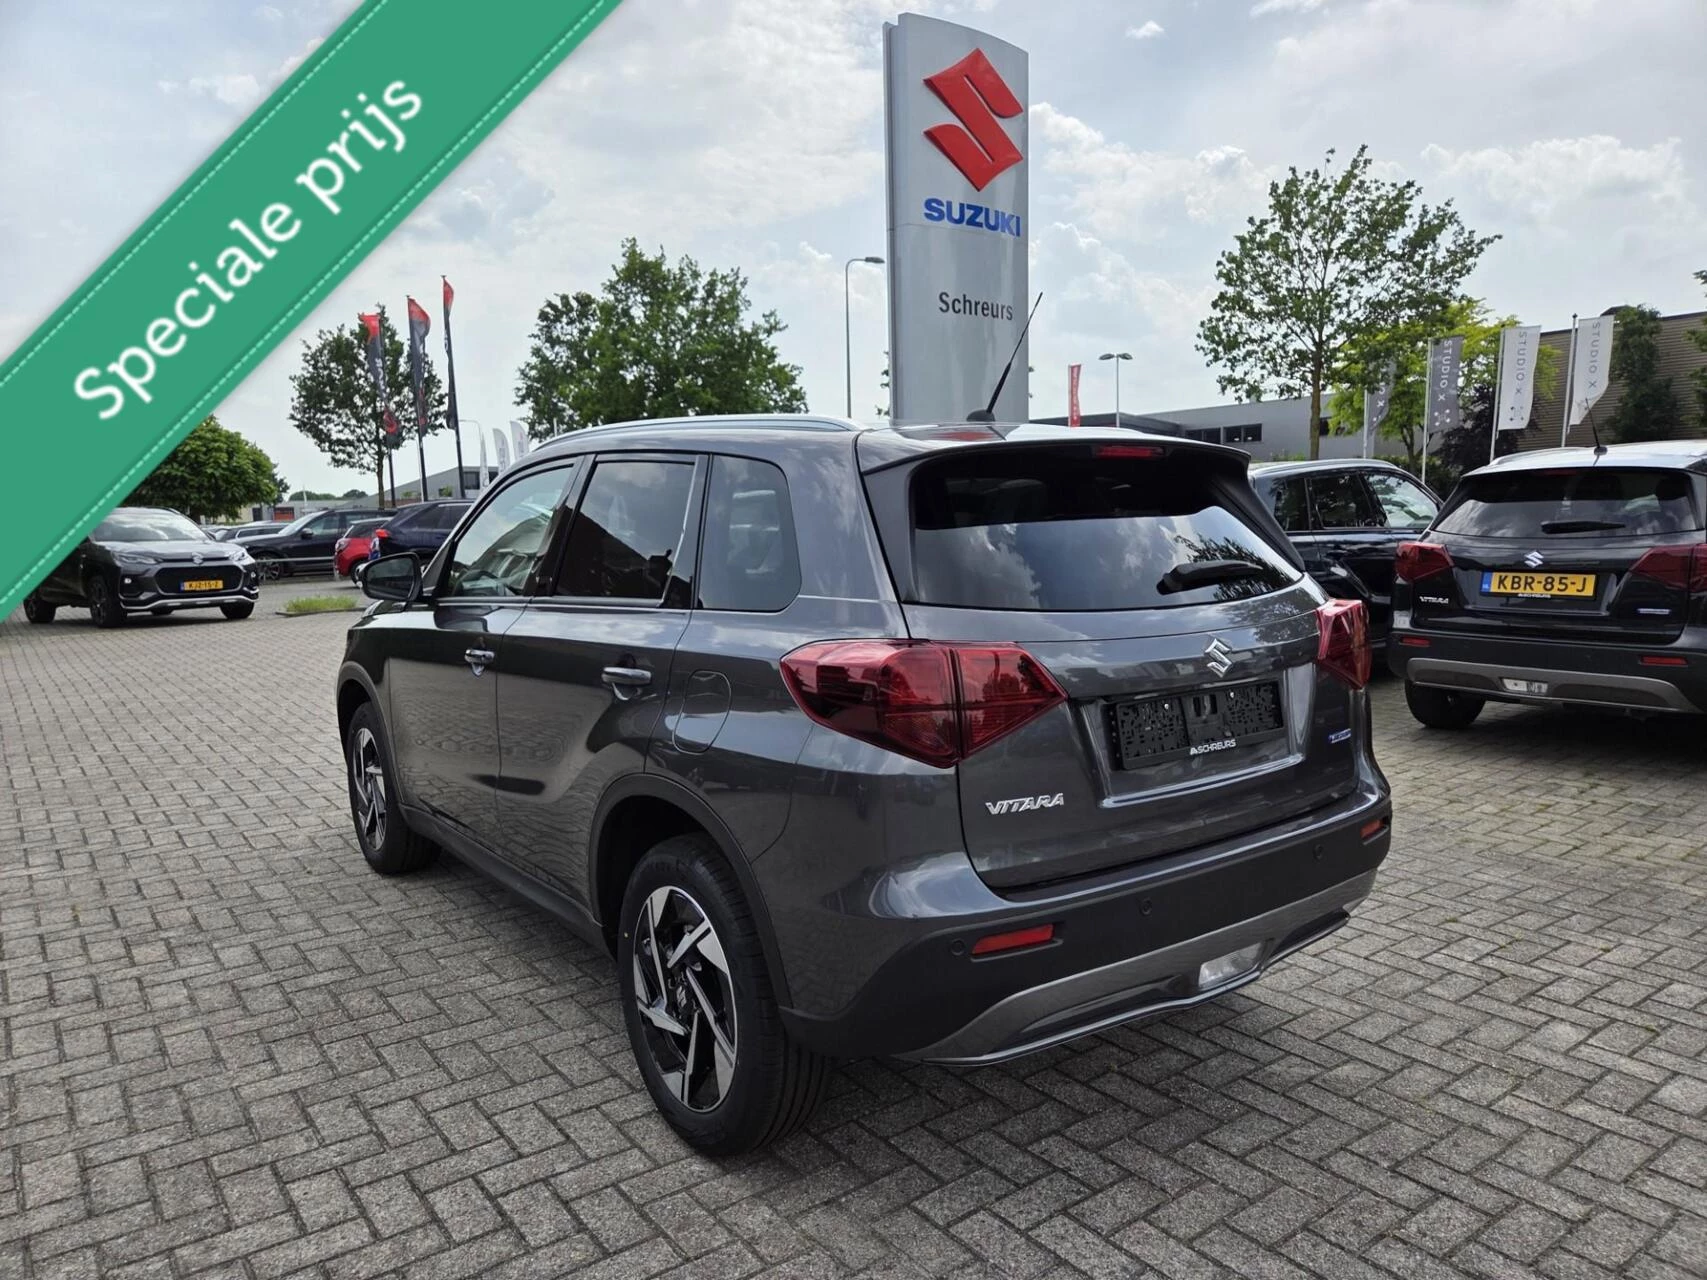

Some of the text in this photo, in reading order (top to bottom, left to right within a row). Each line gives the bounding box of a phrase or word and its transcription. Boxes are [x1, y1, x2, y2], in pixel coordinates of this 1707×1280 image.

[924, 197, 1021, 237] SUZUKI
[938, 291, 1013, 321] Schreurs
[1438, 339, 1453, 389] STUDIO
[1515, 331, 1528, 382] STUDIO
[1588, 322, 1601, 390] STUDIO X
[1497, 574, 1588, 593] KBR-85-J
[985, 792, 1065, 816] VITARA
